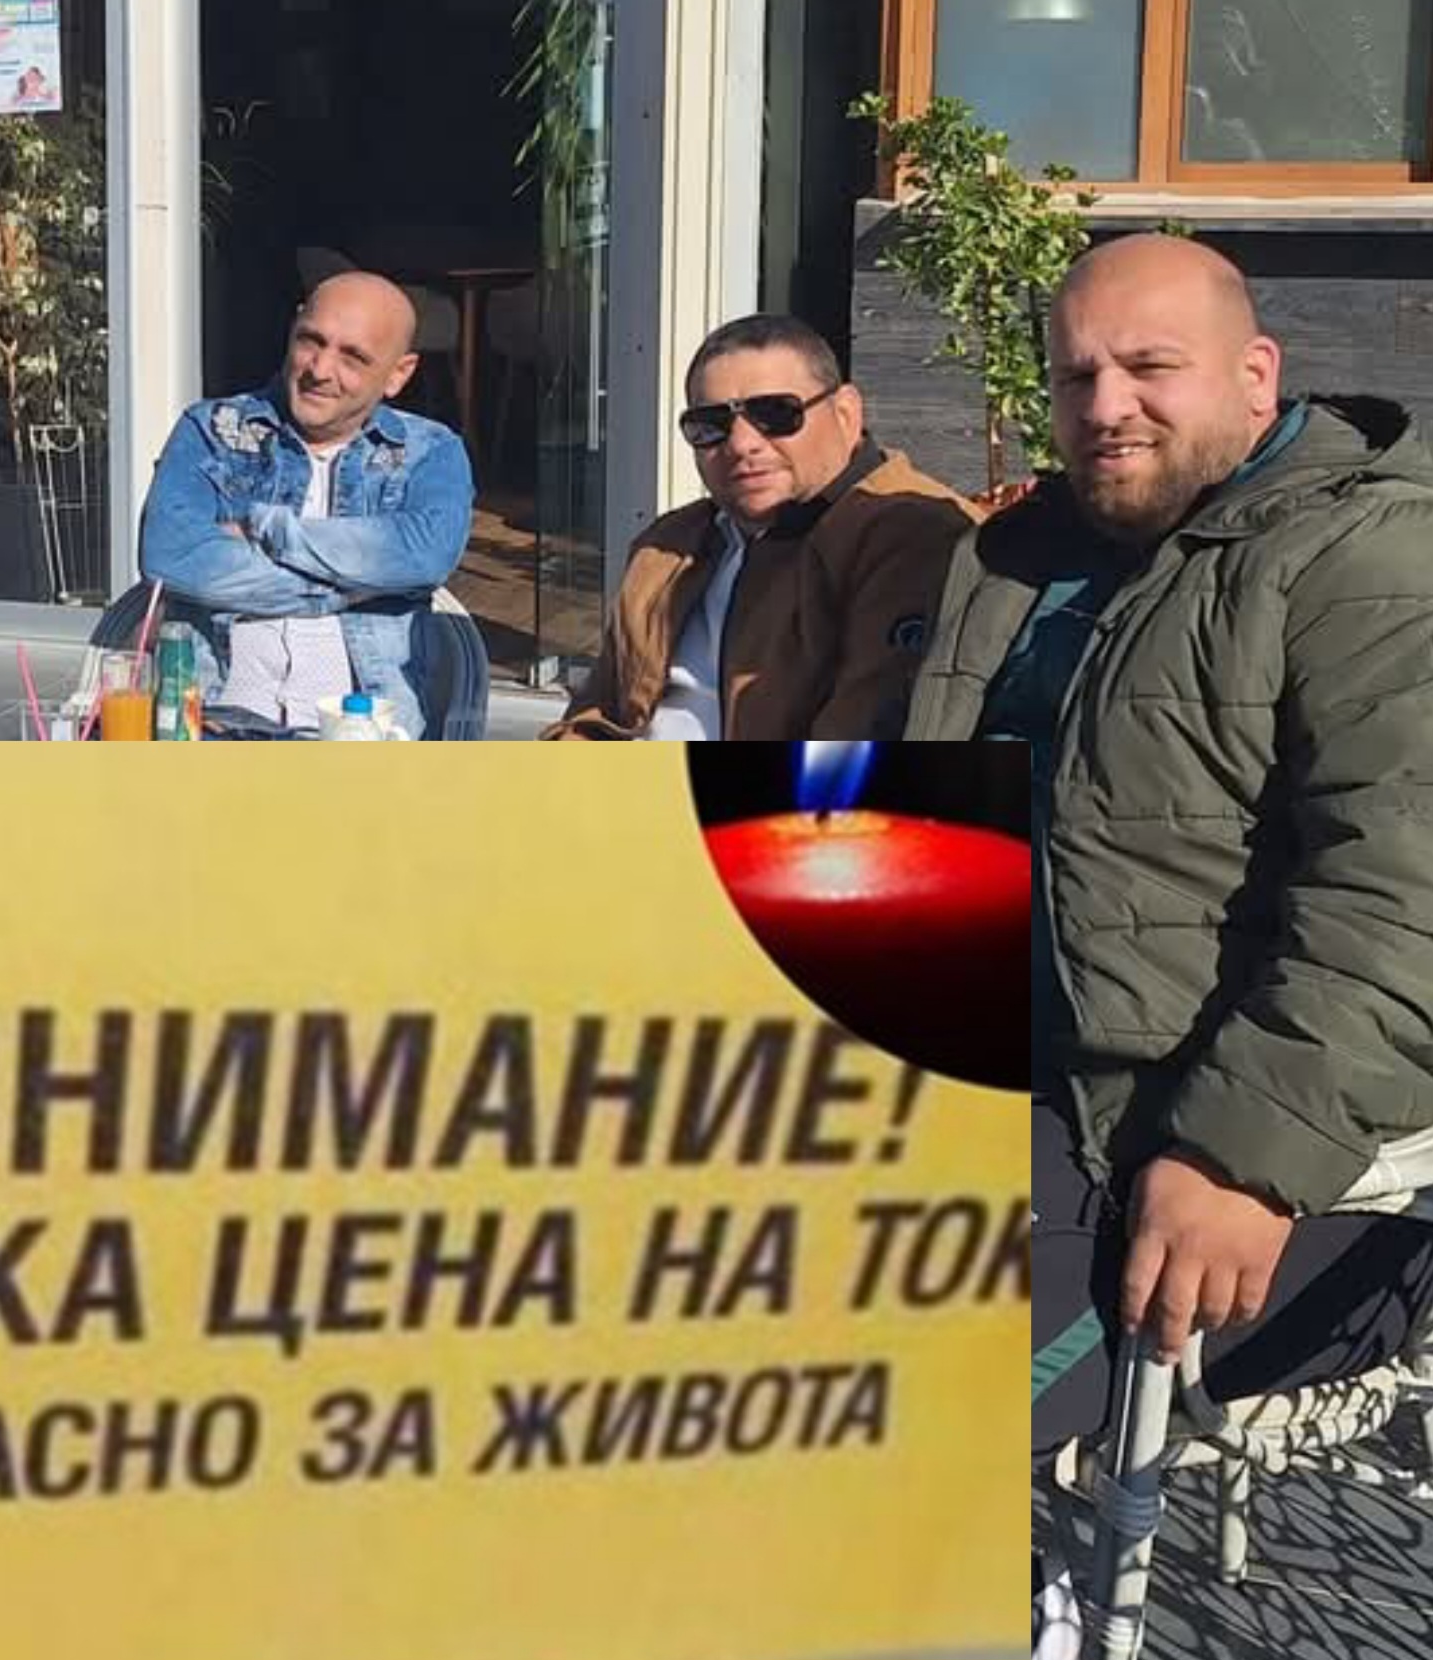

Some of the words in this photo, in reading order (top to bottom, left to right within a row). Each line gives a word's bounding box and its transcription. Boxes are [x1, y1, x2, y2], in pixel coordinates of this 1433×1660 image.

[203, 1208, 578, 1360] ЦЕНА
[626, 1203, 800, 1325] НА
[299, 1386, 437, 1485] ЗА
[471, 1359, 893, 1476] ЖИВОТА
